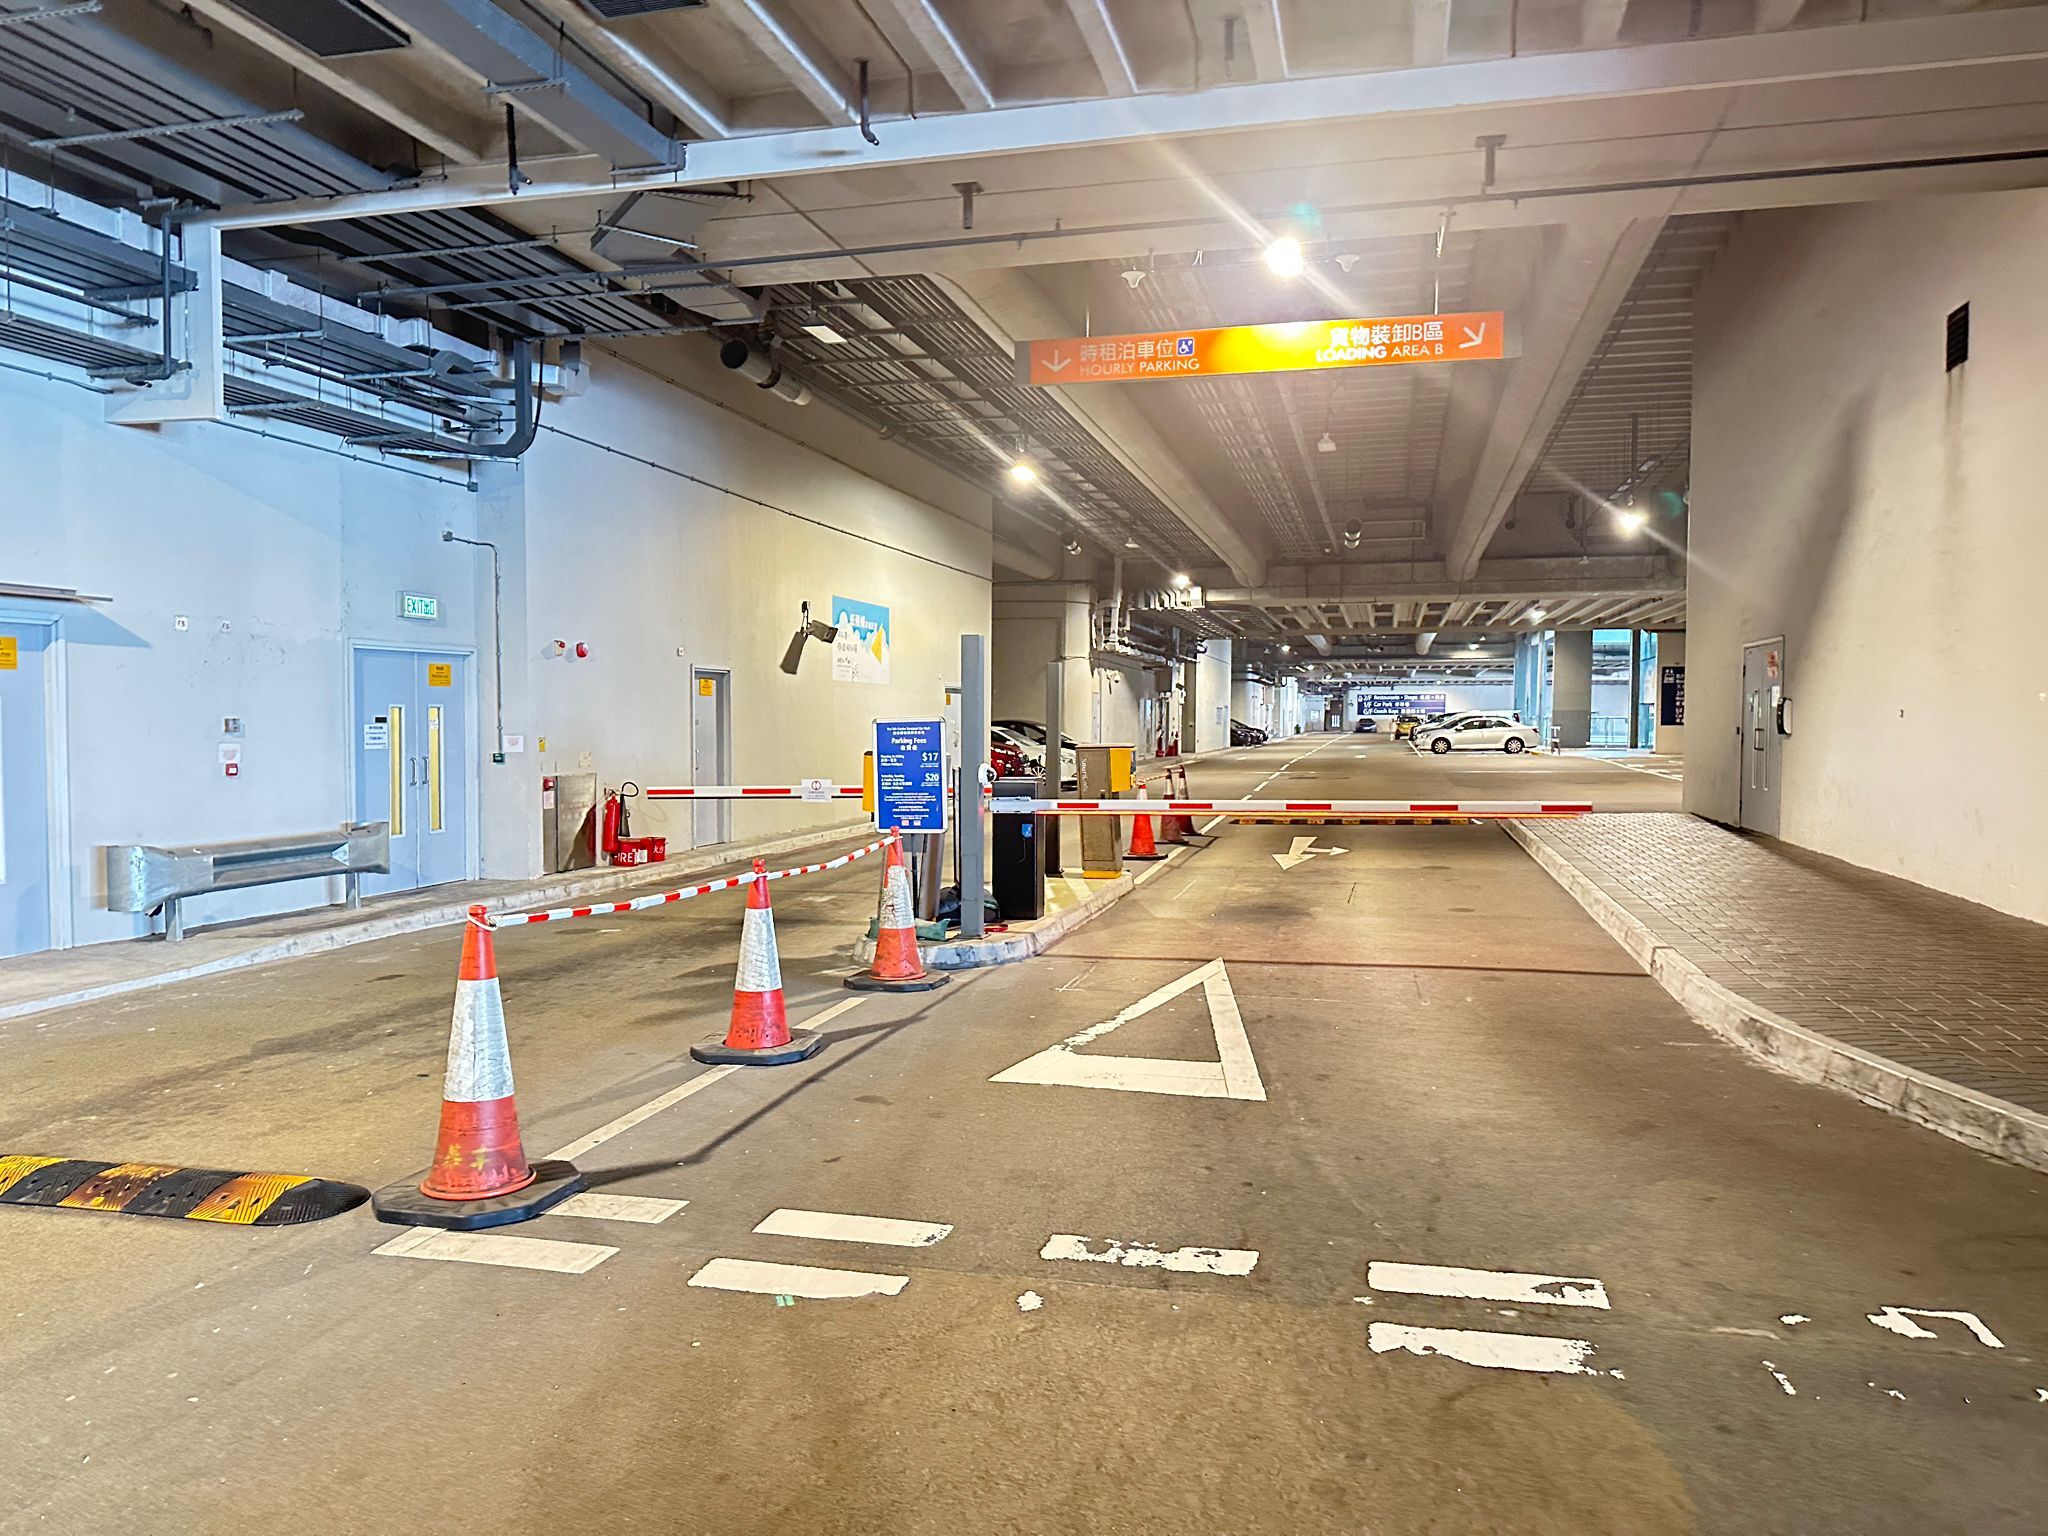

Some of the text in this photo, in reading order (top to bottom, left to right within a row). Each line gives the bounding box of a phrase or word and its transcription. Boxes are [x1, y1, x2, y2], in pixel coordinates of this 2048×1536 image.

[1080, 339, 1174, 361] 時租泊車位
[1315, 343, 1444, 362] LOADING AREA B
[1080, 358, 1200, 377] HOURLY PARKING
[407, 598, 423, 613] EXIT
[424, 600, 434, 615] 出口
[891, 737, 913, 745] Parking
[922, 752, 938, 762] $17
[925, 773, 939, 782] $20
